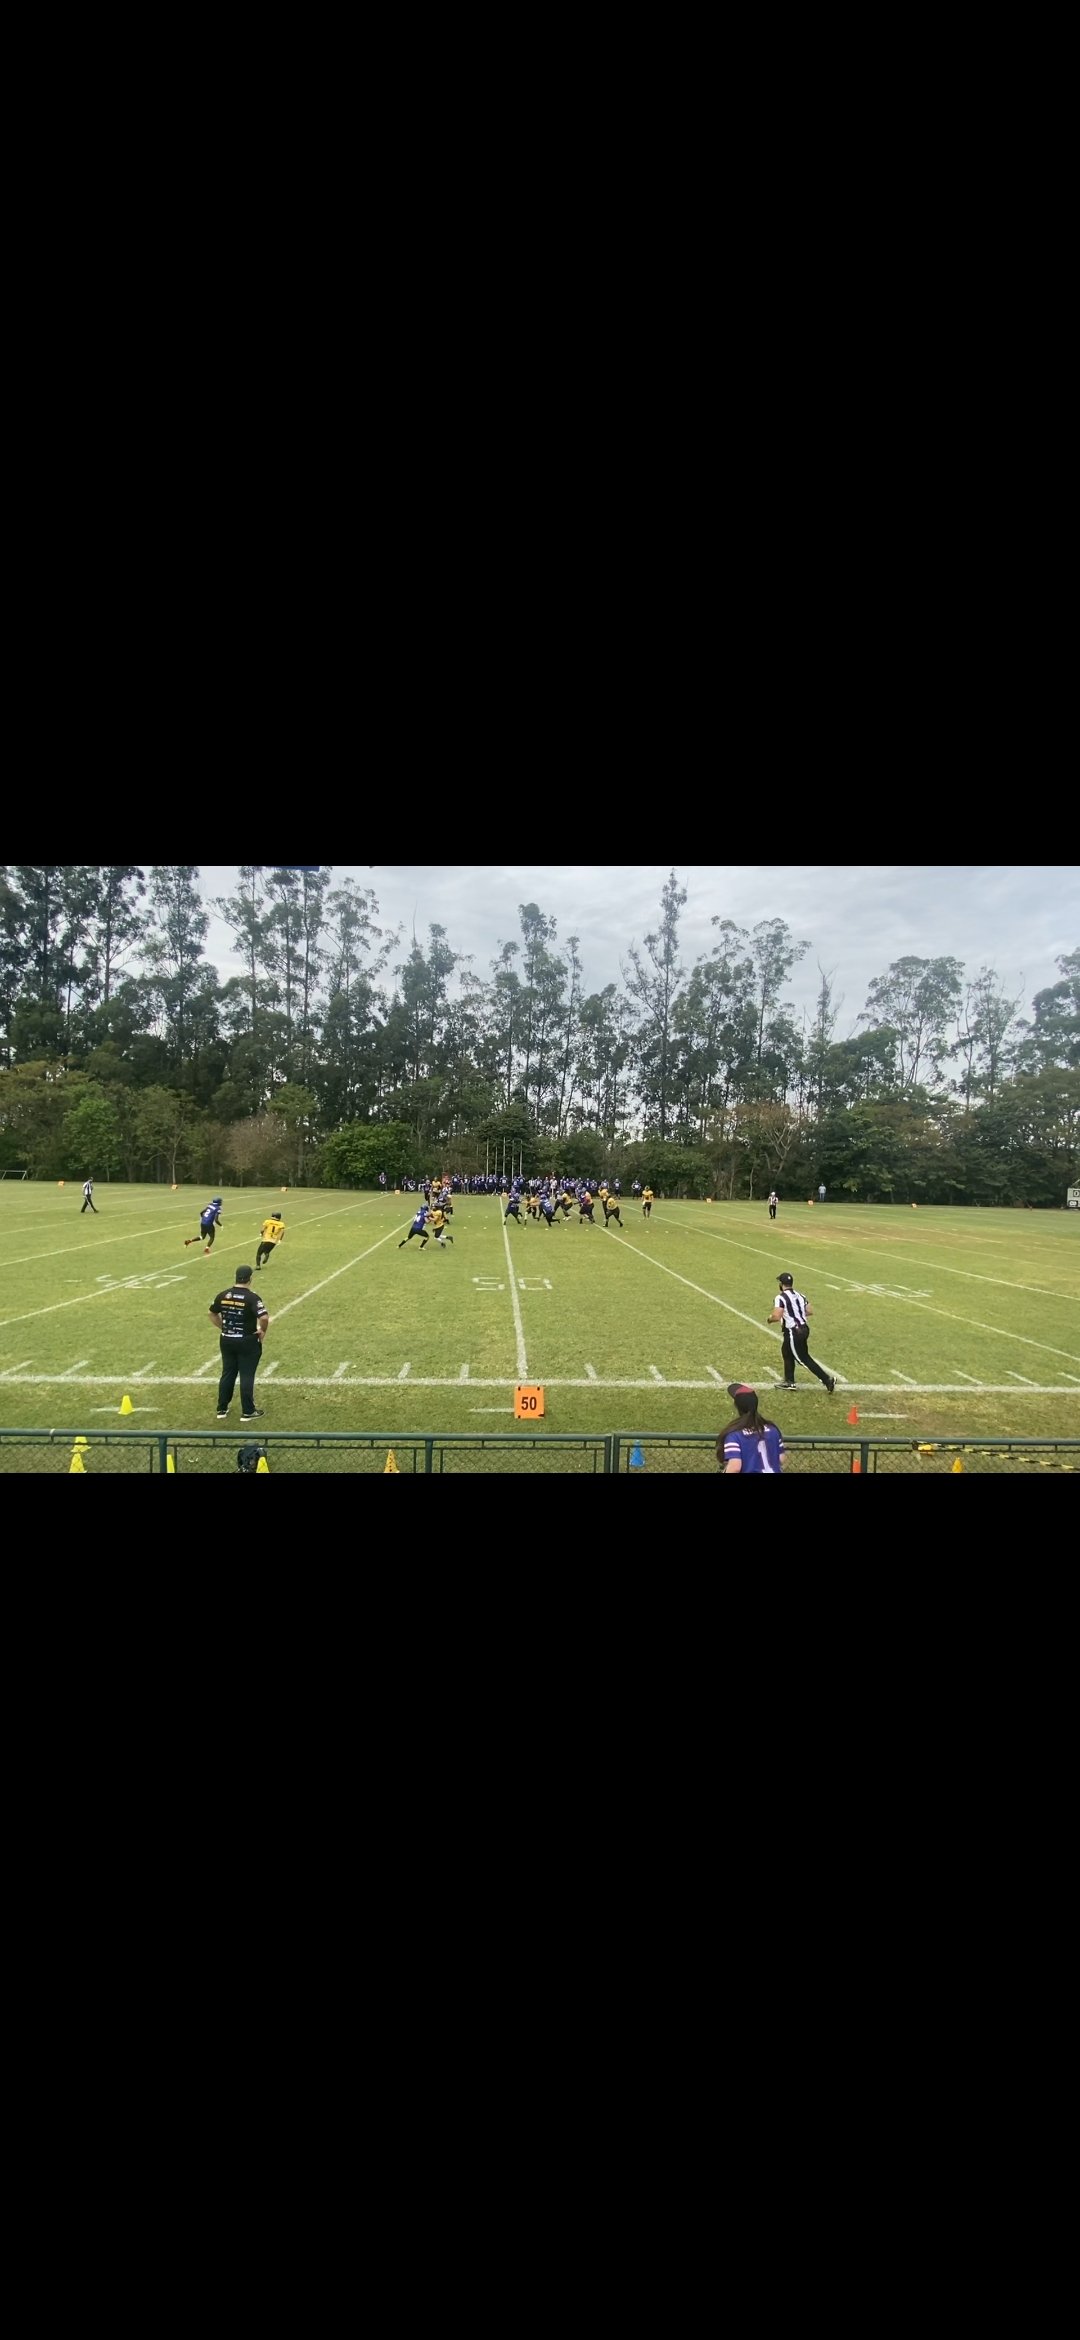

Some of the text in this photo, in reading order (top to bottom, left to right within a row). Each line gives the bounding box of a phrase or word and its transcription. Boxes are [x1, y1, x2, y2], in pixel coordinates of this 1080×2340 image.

[204, 1208, 211, 1218] 2
[472, 1276, 553, 1291] 50
[521, 1396, 537, 1410] 50
[757, 1440, 775, 1473] 1
